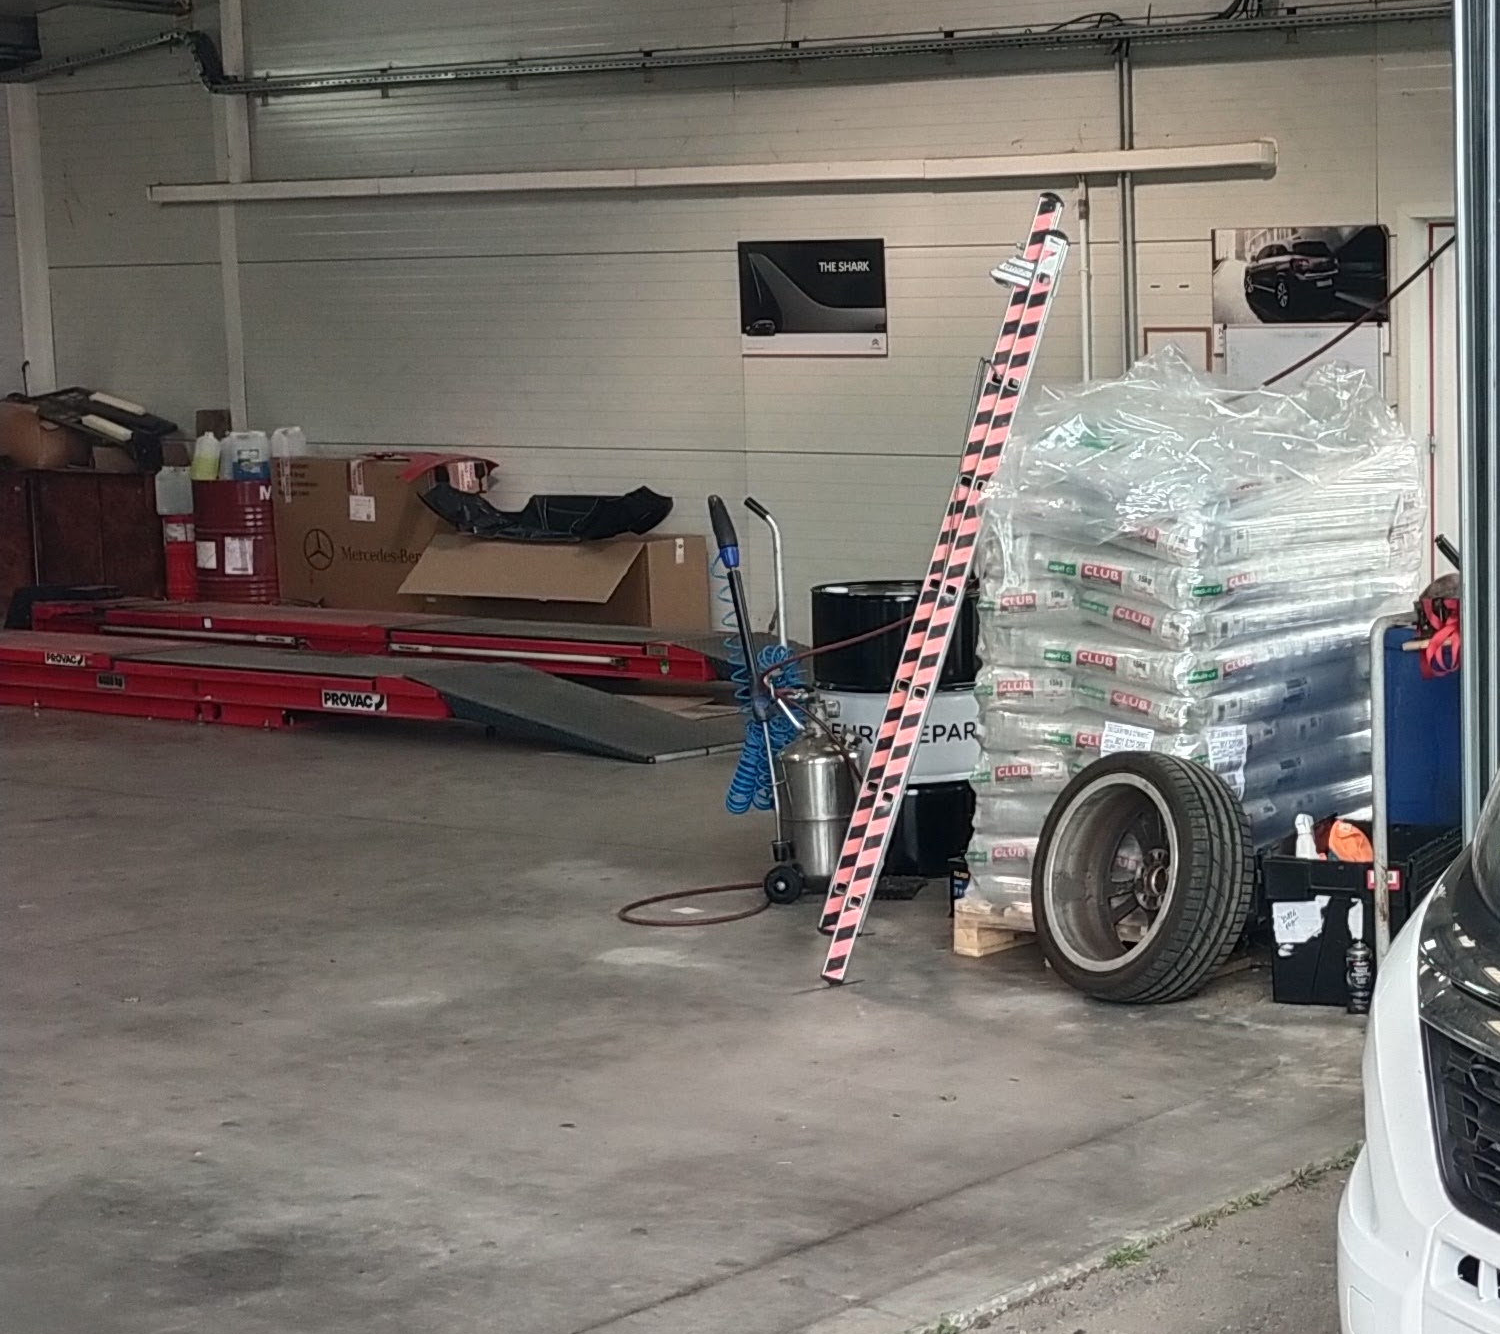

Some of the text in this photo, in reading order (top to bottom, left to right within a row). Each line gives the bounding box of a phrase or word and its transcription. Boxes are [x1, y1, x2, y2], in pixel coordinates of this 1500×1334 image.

[818, 260, 870, 273] THE SHARK
[342, 547, 421, 564] Mercedes-Ben
[1083, 565, 1120, 581] CLUB
[1229, 572, 1257, 587] CLUB
[1001, 594, 1035, 606] CLUB
[1116, 607, 1151, 626] CLUB
[46, 653, 77, 665] PROVAC
[1078, 651, 1114, 667] CLUB
[1224, 658, 1252, 672] CLUB
[999, 680, 1032, 692] CLUB
[323, 691, 374, 709] PROVAC
[1112, 692, 1149, 710] CLUB
[831, 721, 976, 744] EUREPAR
[1078, 733, 1100, 746] CL
[997, 765, 1030, 777] CLUB
[994, 848, 1026, 858] CLUB
